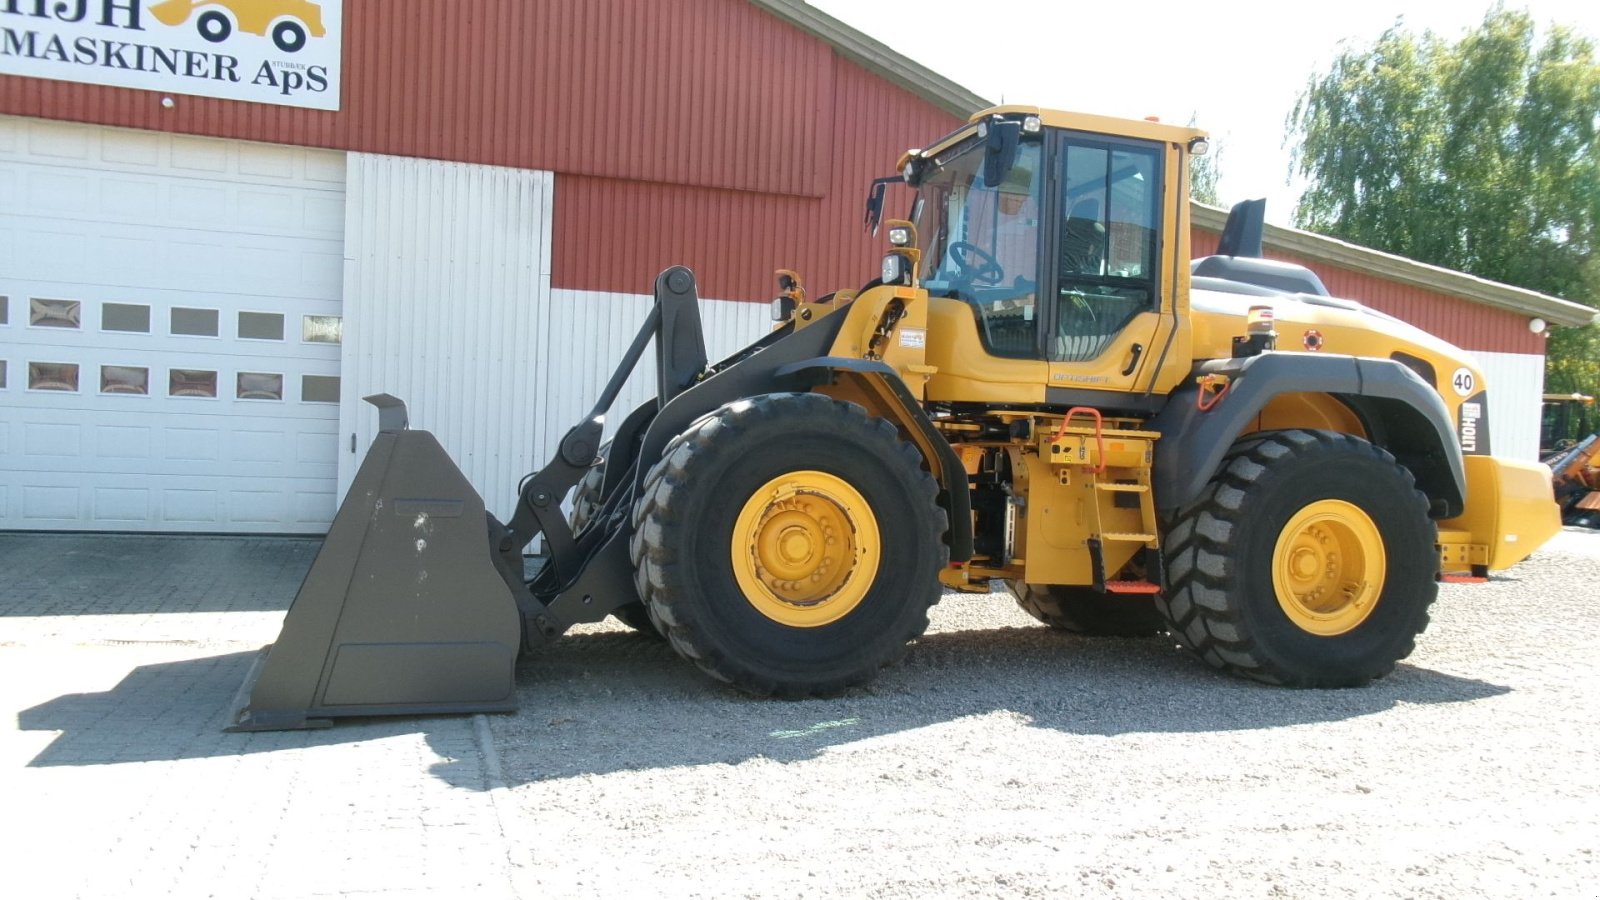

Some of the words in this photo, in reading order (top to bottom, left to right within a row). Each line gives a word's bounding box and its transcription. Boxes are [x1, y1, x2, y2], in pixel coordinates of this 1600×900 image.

[1, 27, 241, 83] MASKINER
[251, 59, 328, 95] ApS
[1454, 373, 1472, 391] 40
[1462, 417, 1476, 452] L110H
